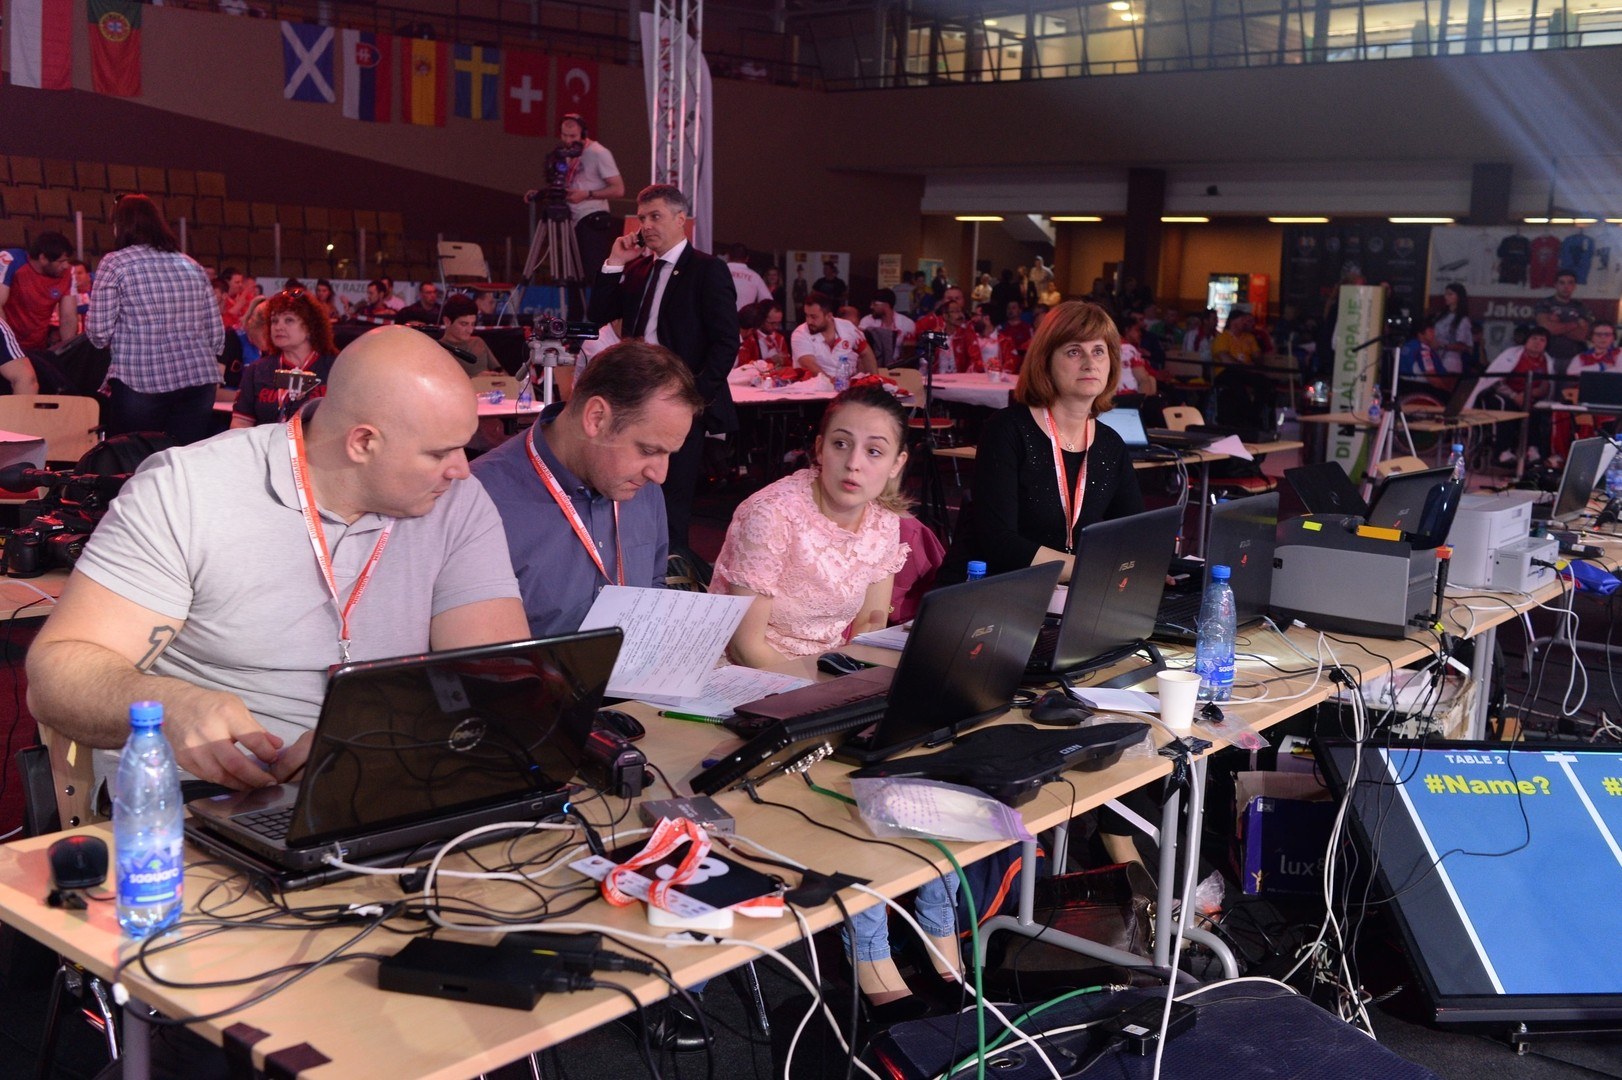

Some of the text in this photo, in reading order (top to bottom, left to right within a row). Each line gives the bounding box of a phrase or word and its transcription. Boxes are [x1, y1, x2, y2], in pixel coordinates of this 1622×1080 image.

[1118, 560, 1136, 572] ASUS
[971, 624, 995, 639] ASUS
[1444, 754, 1506, 765] TABLE 2
[1423, 773, 1552, 796] #Name?
[1280, 854, 1315, 877] lux
